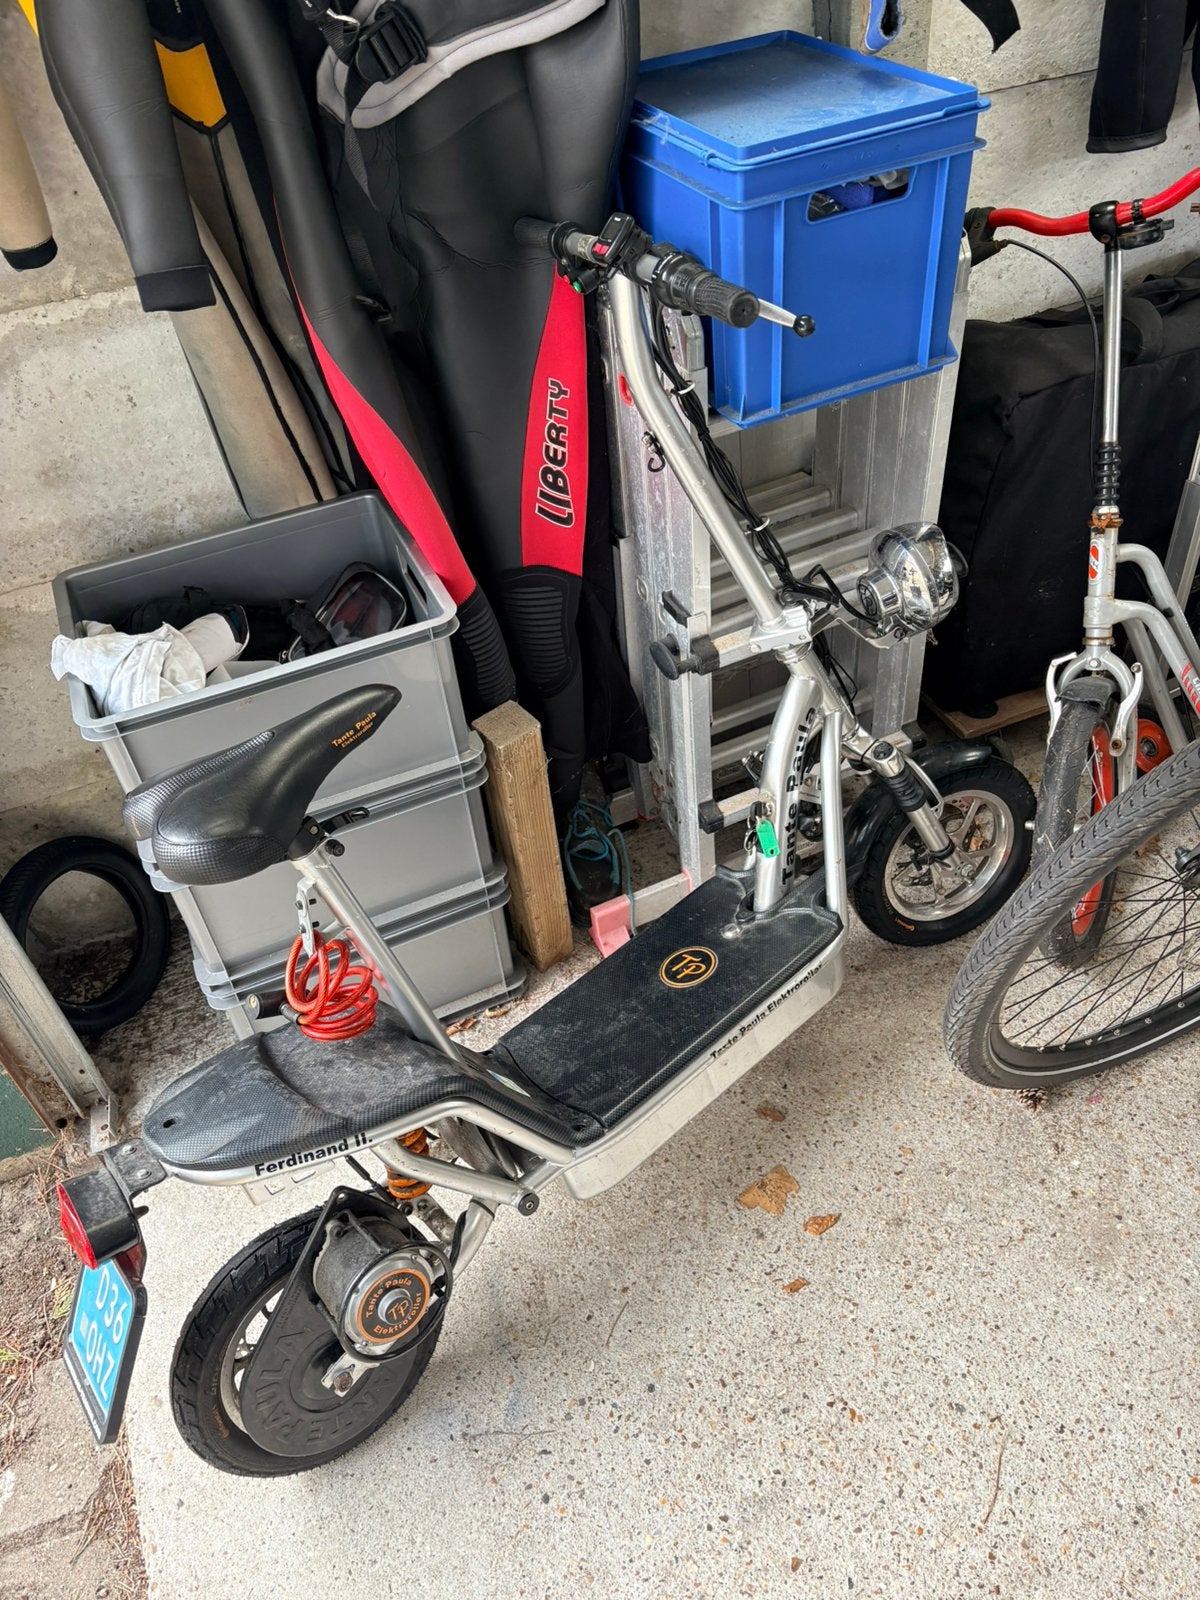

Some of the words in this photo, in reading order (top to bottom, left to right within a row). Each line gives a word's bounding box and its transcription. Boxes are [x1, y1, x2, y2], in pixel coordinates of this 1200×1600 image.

[535, 378, 575, 528] LIBERTY
[331, 729, 355, 747] Tante
[355, 711, 377, 729] Paula
[786, 706, 816, 793] Paula
[781, 803, 799, 885] Tante
[671, 953, 707, 979] TP
[739, 1012, 767, 1037] Paula
[766, 963, 823, 1014] Elektroroller
[254, 1138, 349, 1177] Ferdinand
[366, 1288, 384, 1319] Tante
[384, 1278, 412, 1289] Paula
[373, 1292, 421, 1335] Elektroroller
[85, 1319, 116, 1401] OHZ
